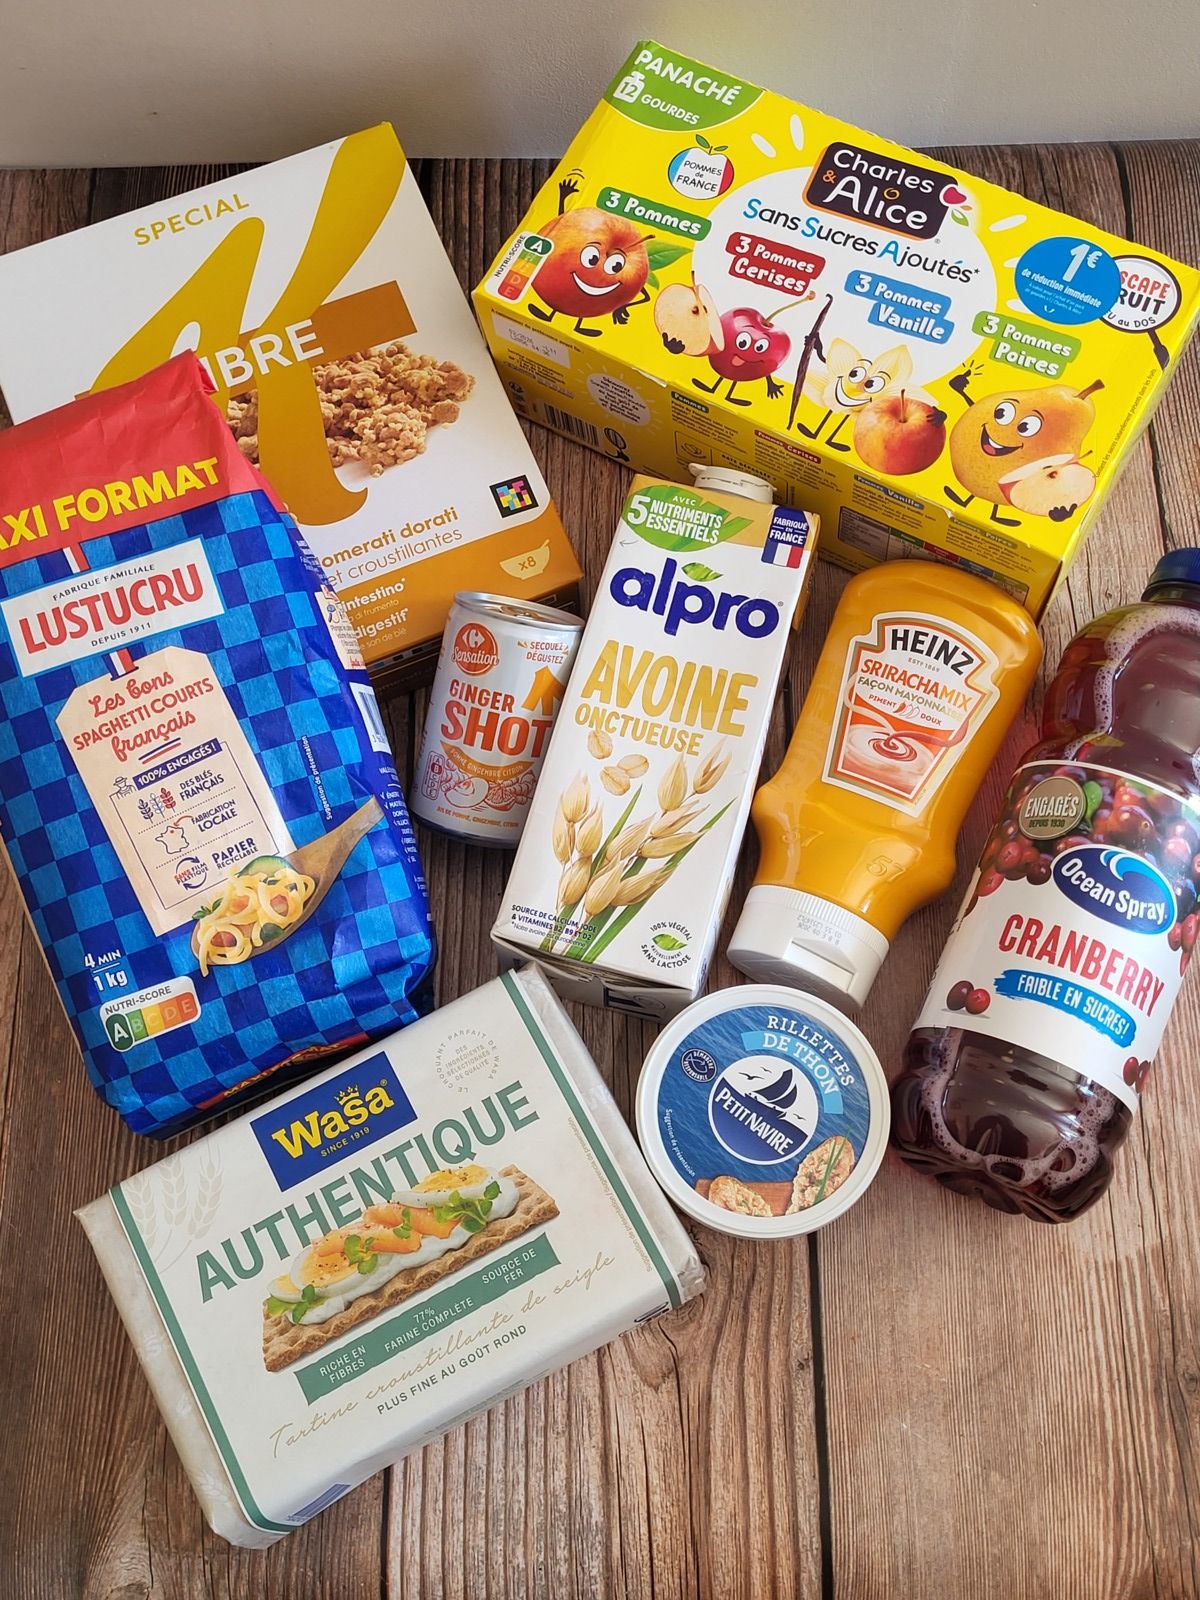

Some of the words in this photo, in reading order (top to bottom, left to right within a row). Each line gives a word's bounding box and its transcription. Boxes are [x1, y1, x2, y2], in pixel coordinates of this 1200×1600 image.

[634, 50, 742, 106] PANACHÉ
[621, 82, 637, 97] 12
[641, 94, 700, 125] GOURDES
[676, 174, 718, 192] FRANCE
[683, 160, 723, 176] POMMES
[822, 170, 837, 185] &
[833, 149, 935, 194] Charles
[134, 193, 250, 246] SPECIAL
[605, 191, 619, 208] 3
[624, 196, 702, 235] Pommes
[823, 175, 928, 230] Alice
[743, 198, 801, 231] Sans
[800, 216, 879, 256] Sucres
[494, 235, 526, 278] NUTRI-SCORE
[530, 240, 545, 252] A
[735, 236, 751, 253] 3
[753, 240, 815, 274] Pommes
[734, 257, 806, 294] Cerises
[1021, 268, 1032, 278] de
[1031, 272, 1064, 292] réduction
[1063, 285, 1102, 308] immédiate
[1120, 271, 1170, 299] SCAPE
[854, 274, 872, 294] 3
[874, 285, 942, 314] Pommes
[1119, 288, 1166, 315] RUIT
[877, 303, 945, 340] Vanille
[982, 315, 1000, 334] 3
[1002, 324, 1072, 357] Pommes
[1118, 319, 1130, 327] au
[1134, 316, 1156, 328] DOS
[199, 318, 324, 391] IBRE
[995, 342, 1060, 377] Poires
[786, 445, 818, 463] Cerises
[53, 457, 219, 531] FORMAT
[627, 494, 651, 525] 5
[650, 500, 723, 529] NUTRIMENTS
[672, 495, 697, 506] AVEC
[887, 486, 921, 508] Vanille
[321, 529, 397, 569] omerati
[400, 507, 459, 539] dorati
[646, 514, 719, 544] ESSENTIELS
[772, 516, 809, 531] FABRIQUÉ
[347, 528, 463, 580] croustillantes
[519, 555, 537, 571] x8
[53, 577, 101, 601] FABRIQUE
[104, 564, 155, 583] FAMILIALE
[610, 557, 780, 639] alpro
[19, 563, 204, 654] LUSTUCRU
[363, 599, 399, 616] frumento
[91, 631, 127, 647] DEPUIS
[130, 622, 152, 635] 1911
[530, 640, 564, 652] SECOUEZ
[891, 628, 974, 676] HEINZ
[451, 647, 500, 667] Sensation
[526, 652, 564, 665] DÉGUSTEZ
[88, 693, 126, 718] Les
[126, 671, 175, 699] bons
[449, 678, 515, 713] GINGER
[581, 639, 759, 737] AVOINE
[857, 676, 894, 694] FAÇON
[861, 658, 972, 712] SRIRACHAMIX
[73, 704, 151, 751] SPAGHETTI
[150, 677, 214, 714] COURTS
[868, 694, 897, 708] PIMENT
[920, 713, 942, 726] DOUX
[111, 710, 196, 763] français
[441, 700, 554, 758] SHOT
[575, 702, 704, 756] ONCTUEUSE
[301, 735, 319, 776] présentation
[467, 762, 501, 777] GINGEMBRE
[502, 764, 524, 777] CITRON
[137, 769, 167, 786] 100%
[179, 778, 195, 790] DES
[195, 769, 213, 785] BLÉS
[179, 774, 225, 801] FRANÇAIS
[191, 799, 236, 825] FABRICATION
[198, 808, 238, 832] LOCALE
[318, 785, 333, 820] Suggestion
[1023, 793, 1080, 819] ENGAGÉS
[1028, 819, 1048, 829] DEPUIS
[1049, 818, 1066, 829] 1930
[212, 837, 256, 864] PAPIER
[216, 847, 259, 870] RECYCLABLE
[174, 869, 192, 881] SANS
[191, 862, 207, 873] FILM
[176, 866, 209, 885] PLASTIQUE
[1060, 857, 1114, 906] Ocean
[1114, 889, 1166, 926] Spray
[511, 904, 539, 917] SOURCE
[538, 911, 547, 920] DE
[581, 922, 597, 933] IODE
[518, 914, 554, 930] VITAMINES
[650, 921, 667, 932] 100%
[668, 921, 692, 941] VÉGÉTAL
[84, 953, 95, 968] 4
[98, 949, 122, 966] MIN
[641, 944, 657, 963] SANS
[656, 954, 691, 968] LACTOSE
[998, 913, 1165, 1018] CRANBERRY
[93, 976, 104, 991] 1
[105, 970, 128, 988] kg
[105, 985, 172, 1016] NUTRI-SCORE
[1017, 974, 1064, 1000] FAIBLE
[1065, 989, 1082, 1006] EN
[1083, 996, 1129, 1039] SUCRES!
[114, 1022, 130, 1043] A
[132, 1018, 144, 1033] B
[165, 1006, 177, 1021] D
[182, 999, 193, 1014] E
[447, 1029, 487, 1040] PARFAIT
[487, 1056, 500, 1080] WASA
[763, 1033, 790, 1052] DE
[795, 1042, 839, 1096] THON
[767, 1015, 855, 1087] RILLETTES
[272, 1084, 394, 1159] Wasa
[320, 1138, 349, 1158] SINCE
[350, 1126, 370, 1143] 1919
[663, 1108, 675, 1139] Suggestion
[672, 1146, 696, 1177] présentation
[196, 1079, 540, 1303] AUTHENTIQUE
[481, 1256, 519, 1285] SOURCE
[519, 1247, 537, 1265] DE
[503, 1267, 525, 1285] FER
[384, 1325, 421, 1353] FARINE
[421, 1296, 474, 1333] COMPLÈTE
[413, 1306, 436, 1323] 77%
[270, 1400, 358, 1458] Tartine
[365, 1310, 514, 1401] croustillante
[520, 1290, 546, 1314] de
[554, 1251, 615, 1295] seigle
[319, 1352, 352, 1377] RICHE
[352, 1344, 367, 1359] EN
[328, 1356, 366, 1384] FIBRES
[376, 1390, 408, 1415] PLUS
[410, 1375, 439, 1397] FINE
[440, 1363, 457, 1380] AU
[458, 1344, 493, 1371] GOÛT
[494, 1324, 528, 1351] ROND
